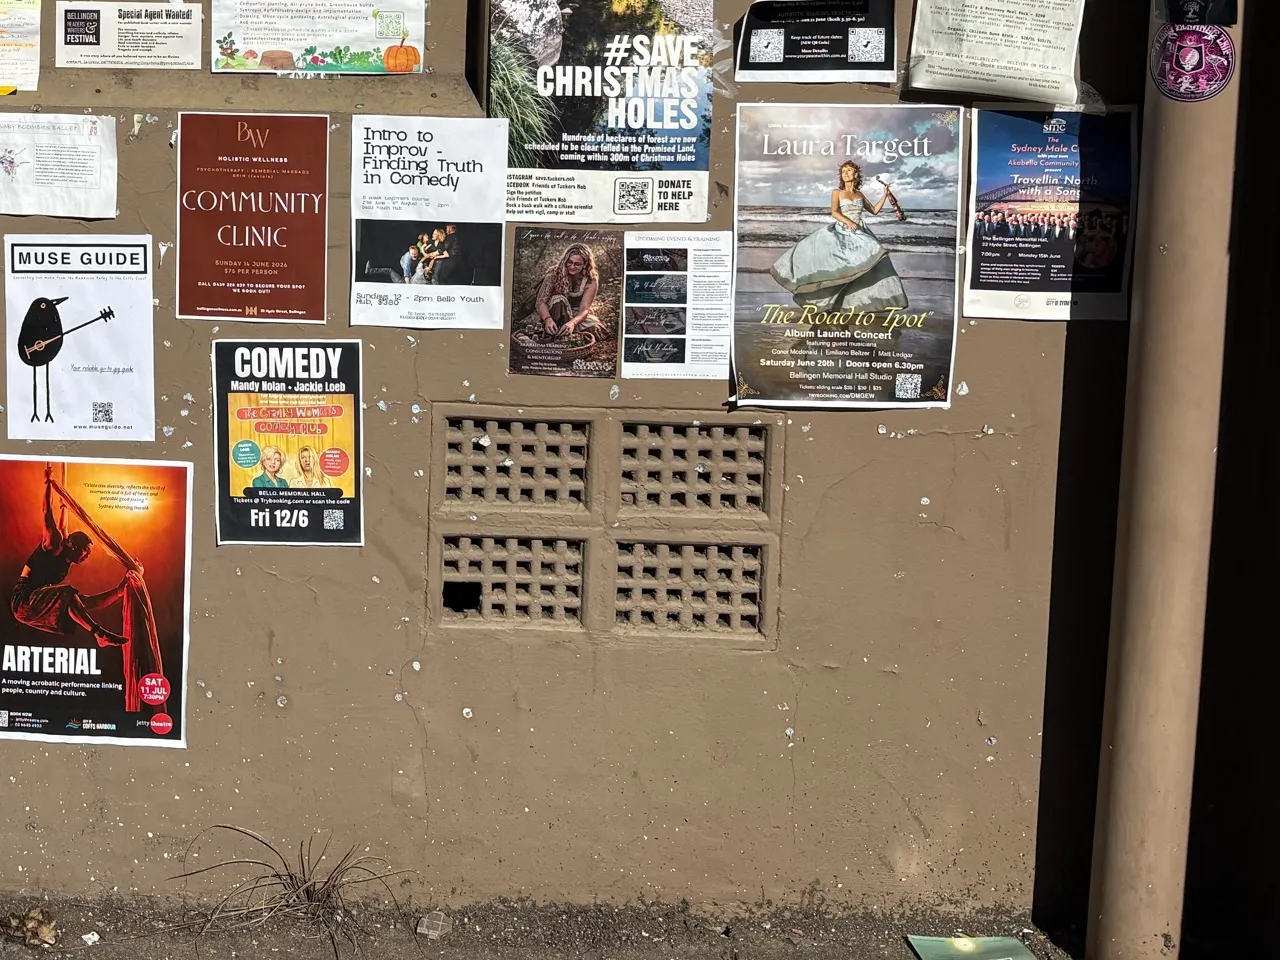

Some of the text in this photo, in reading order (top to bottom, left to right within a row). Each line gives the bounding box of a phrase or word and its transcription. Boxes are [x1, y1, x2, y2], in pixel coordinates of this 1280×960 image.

[118, 9, 192, 20] Special Agent Wanted!
[67, 35, 97, 43] FESTIVAL
[604, 34, 699, 66] #SAVE
[536, 65, 699, 98] CHRISTMAS
[608, 98, 698, 130] HOLES
[363, 127, 433, 143] Intro to
[363, 142, 428, 159] Improv
[762, 133, 932, 164] Laura Targett
[363, 157, 483, 174] Finding Truth
[363, 172, 459, 192] in Comedy
[658, 180, 692, 189] DONATE
[183, 190, 323, 214] COMMUNITY
[658, 191, 693, 200] TO HELP
[658, 202, 680, 211] HERE
[217, 225, 287, 248] CLINIC
[19, 252, 140, 265] MUSE GUIDE
[784, 328, 892, 340] Album Launch Concert
[234, 346, 342, 379] COMEDY
[251, 508, 309, 527] Fri 12/6
[2, 644, 102, 675] ARTERIAL
